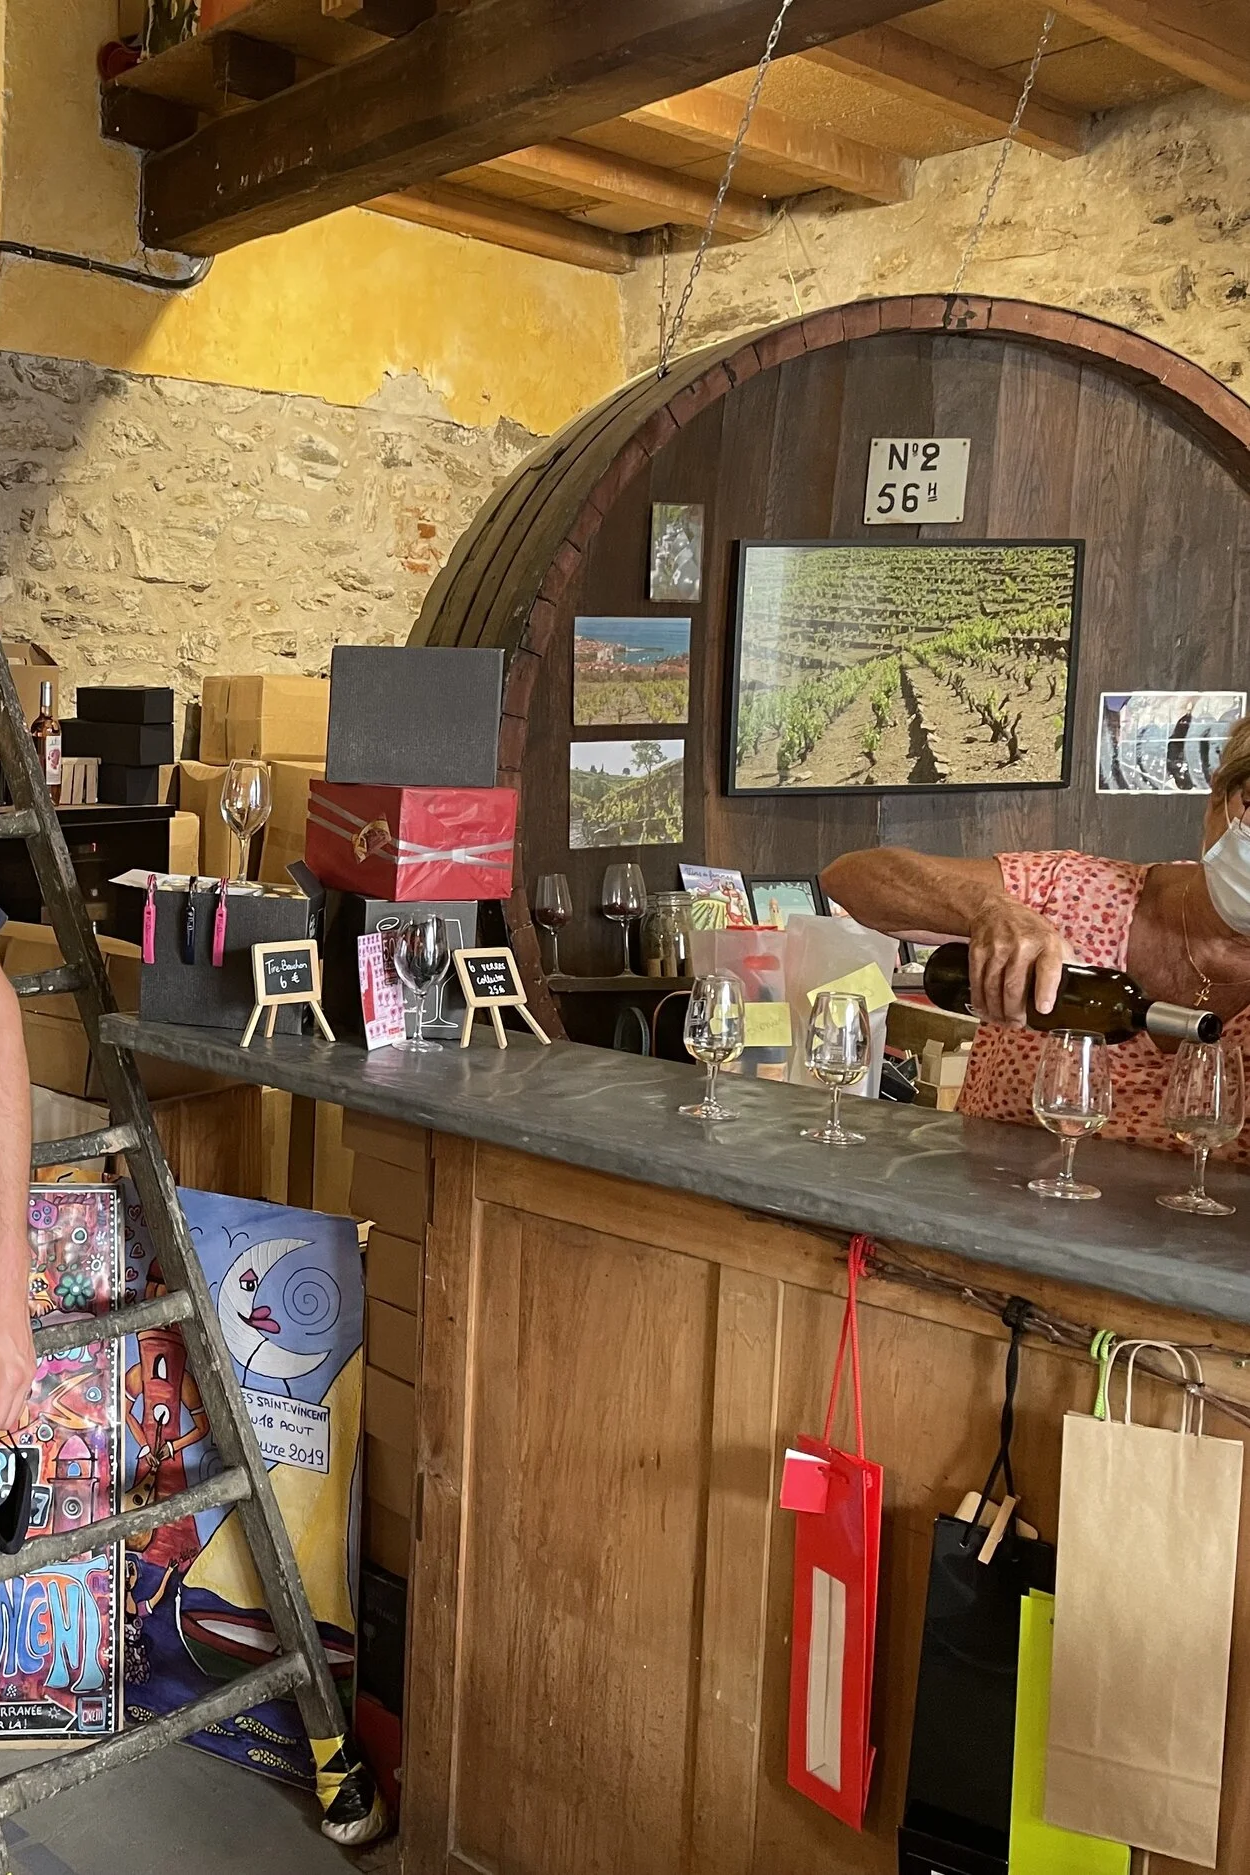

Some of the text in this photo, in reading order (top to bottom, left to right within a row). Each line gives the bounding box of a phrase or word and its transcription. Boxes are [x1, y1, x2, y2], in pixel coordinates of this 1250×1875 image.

[468, 960, 476, 973] 6
[280, 975, 287, 989] 6
[280, 1420, 314, 1436] AOUT
[289, 1443, 324, 1466] 2019
